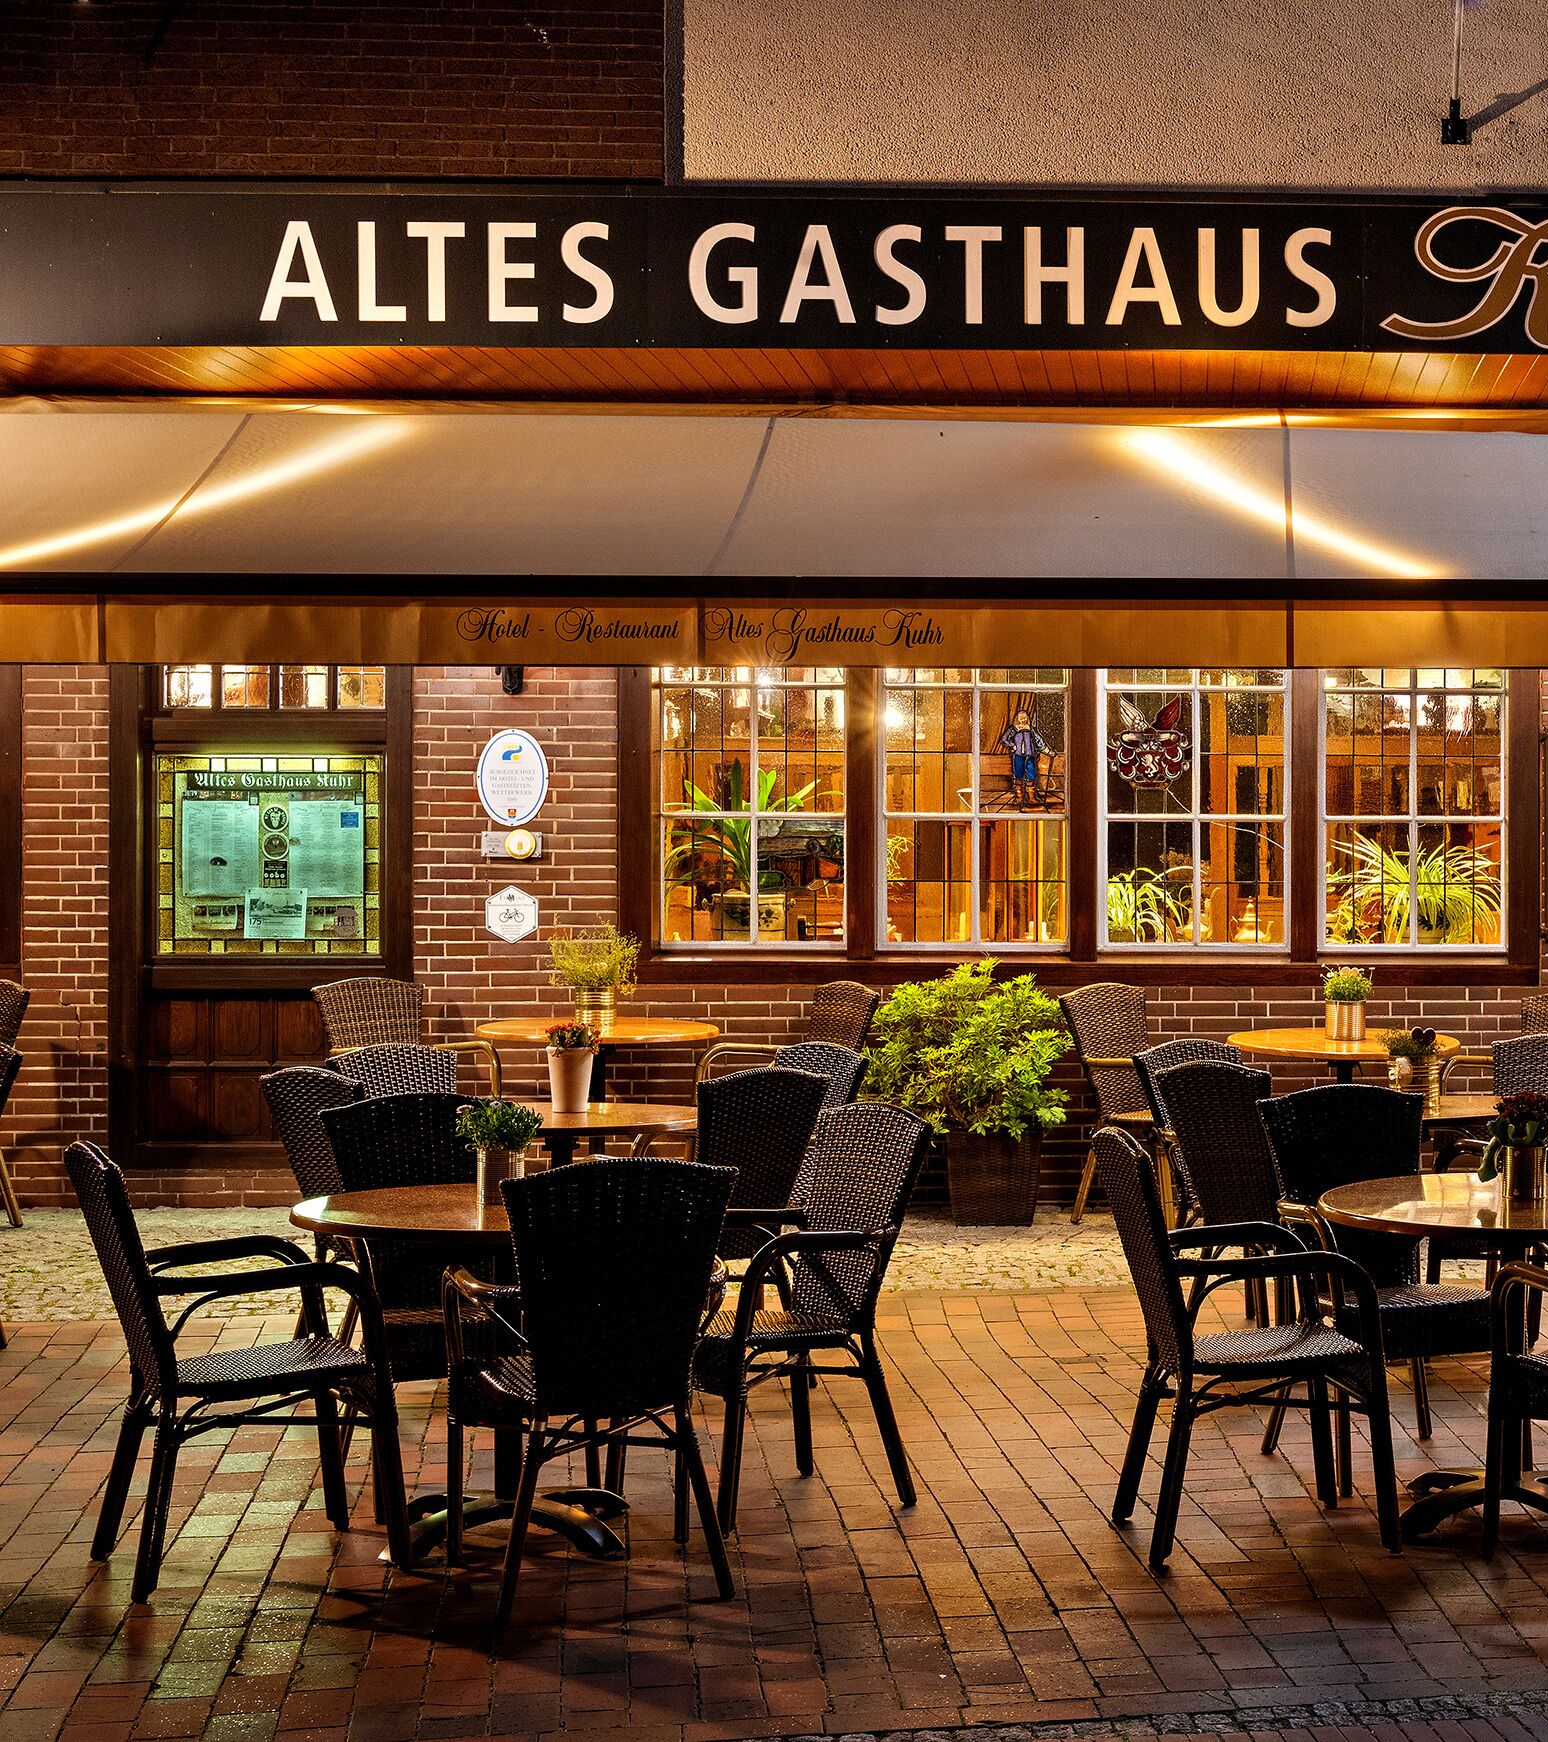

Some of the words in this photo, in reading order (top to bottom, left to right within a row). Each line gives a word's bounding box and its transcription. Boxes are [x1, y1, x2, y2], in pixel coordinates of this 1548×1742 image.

[258, 219, 616, 325] ALTES
[688, 222, 1338, 327] GASTHAUS
[456, 606, 530, 643] Hotel
[554, 606, 680, 643] Restaurant
[700, 606, 764, 644] Altes
[765, 606, 876, 662] Gasthaus
[875, 608, 945, 648] Kuhr
[194, 772, 236, 788] Altes
[241, 772, 312, 789] Gasthaus
[316, 772, 354, 789] Kuhr
[249, 917, 262, 926] 175
